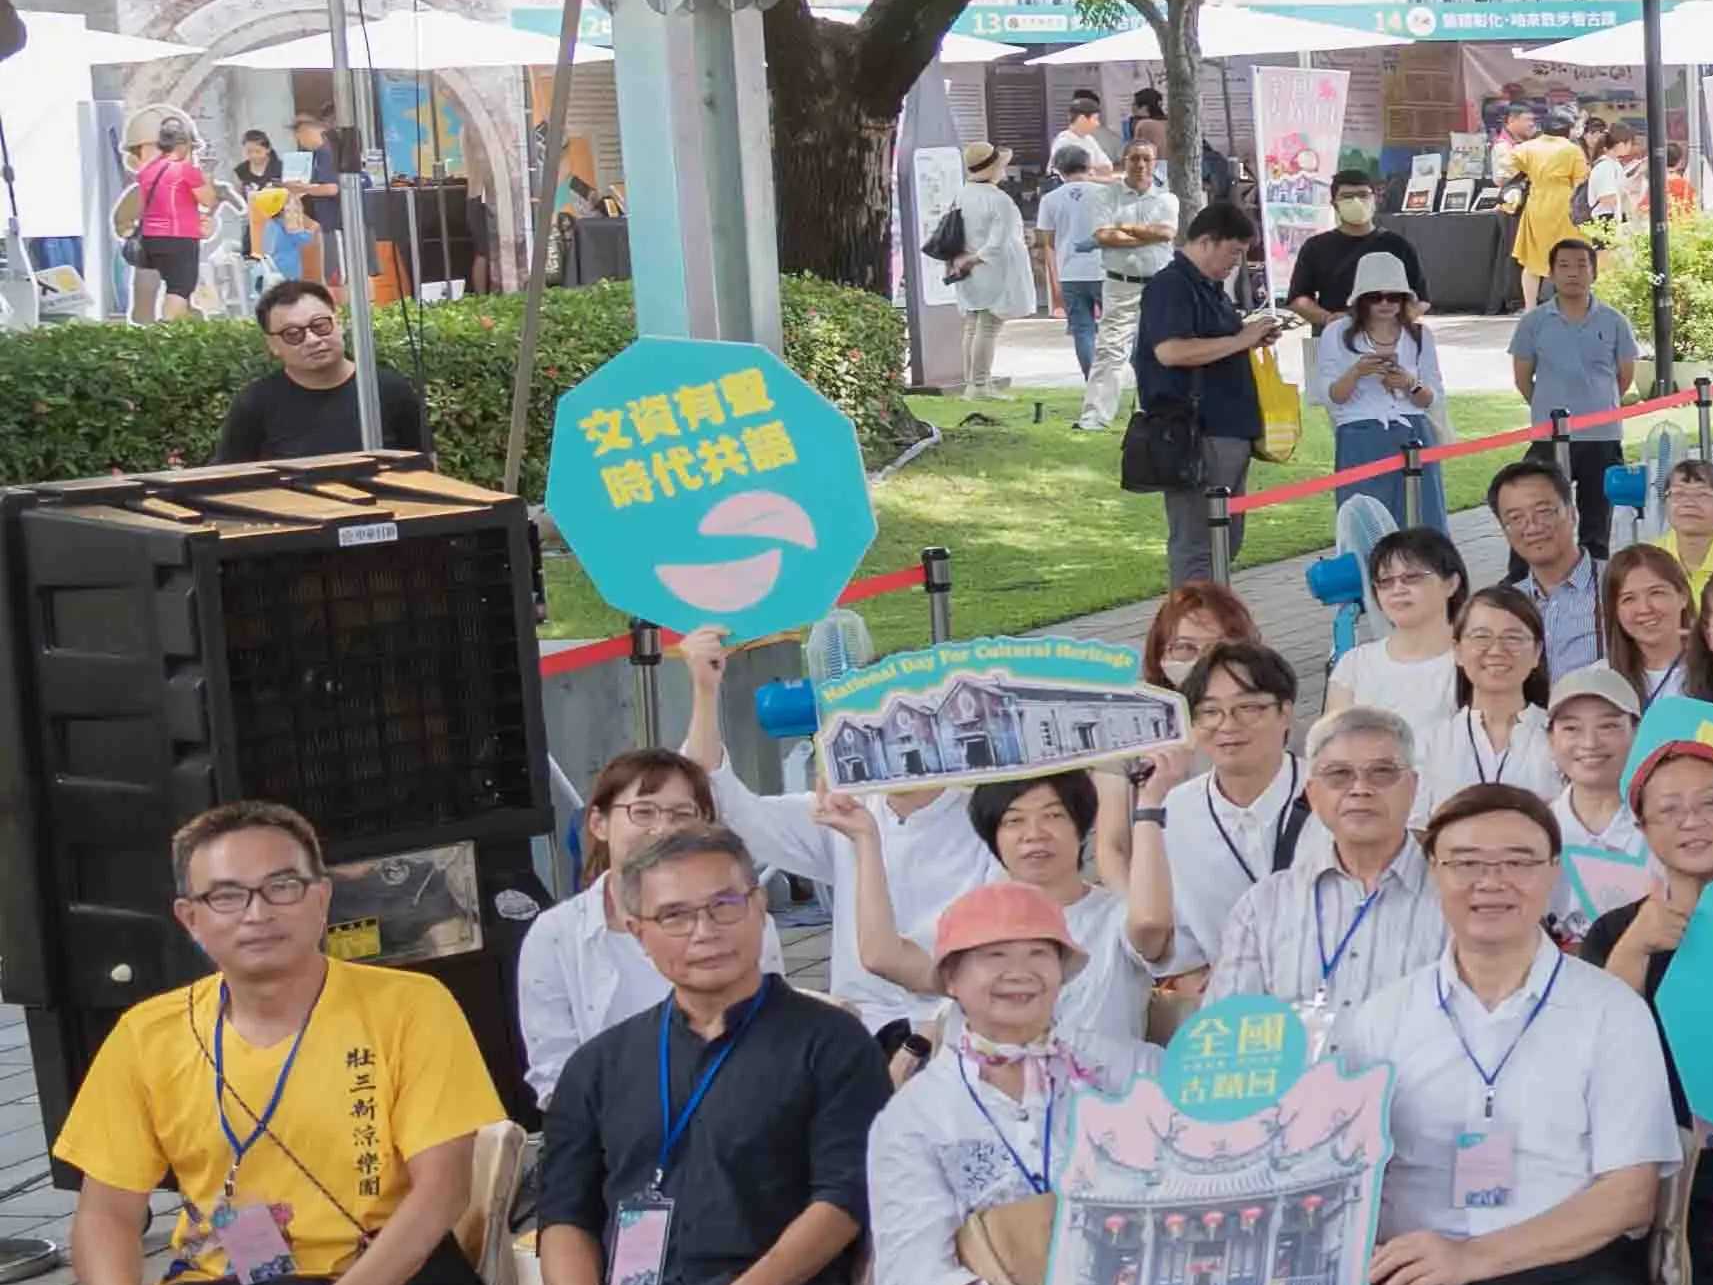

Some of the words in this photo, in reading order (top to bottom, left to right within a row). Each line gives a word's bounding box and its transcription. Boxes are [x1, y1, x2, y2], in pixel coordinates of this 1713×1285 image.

[973, 12, 1002, 34] 13
[1374, 12, 1402, 33] 14
[577, 367, 776, 457] 文資有聲
[601, 419, 798, 509] 時代共語
[823, 666, 897, 703] National
[901, 656, 936, 675] Day
[938, 648, 970, 665] For
[975, 643, 1051, 660] Cultural
[1055, 645, 1134, 668] Heritage
[1183, 1013, 1286, 1058] 全國
